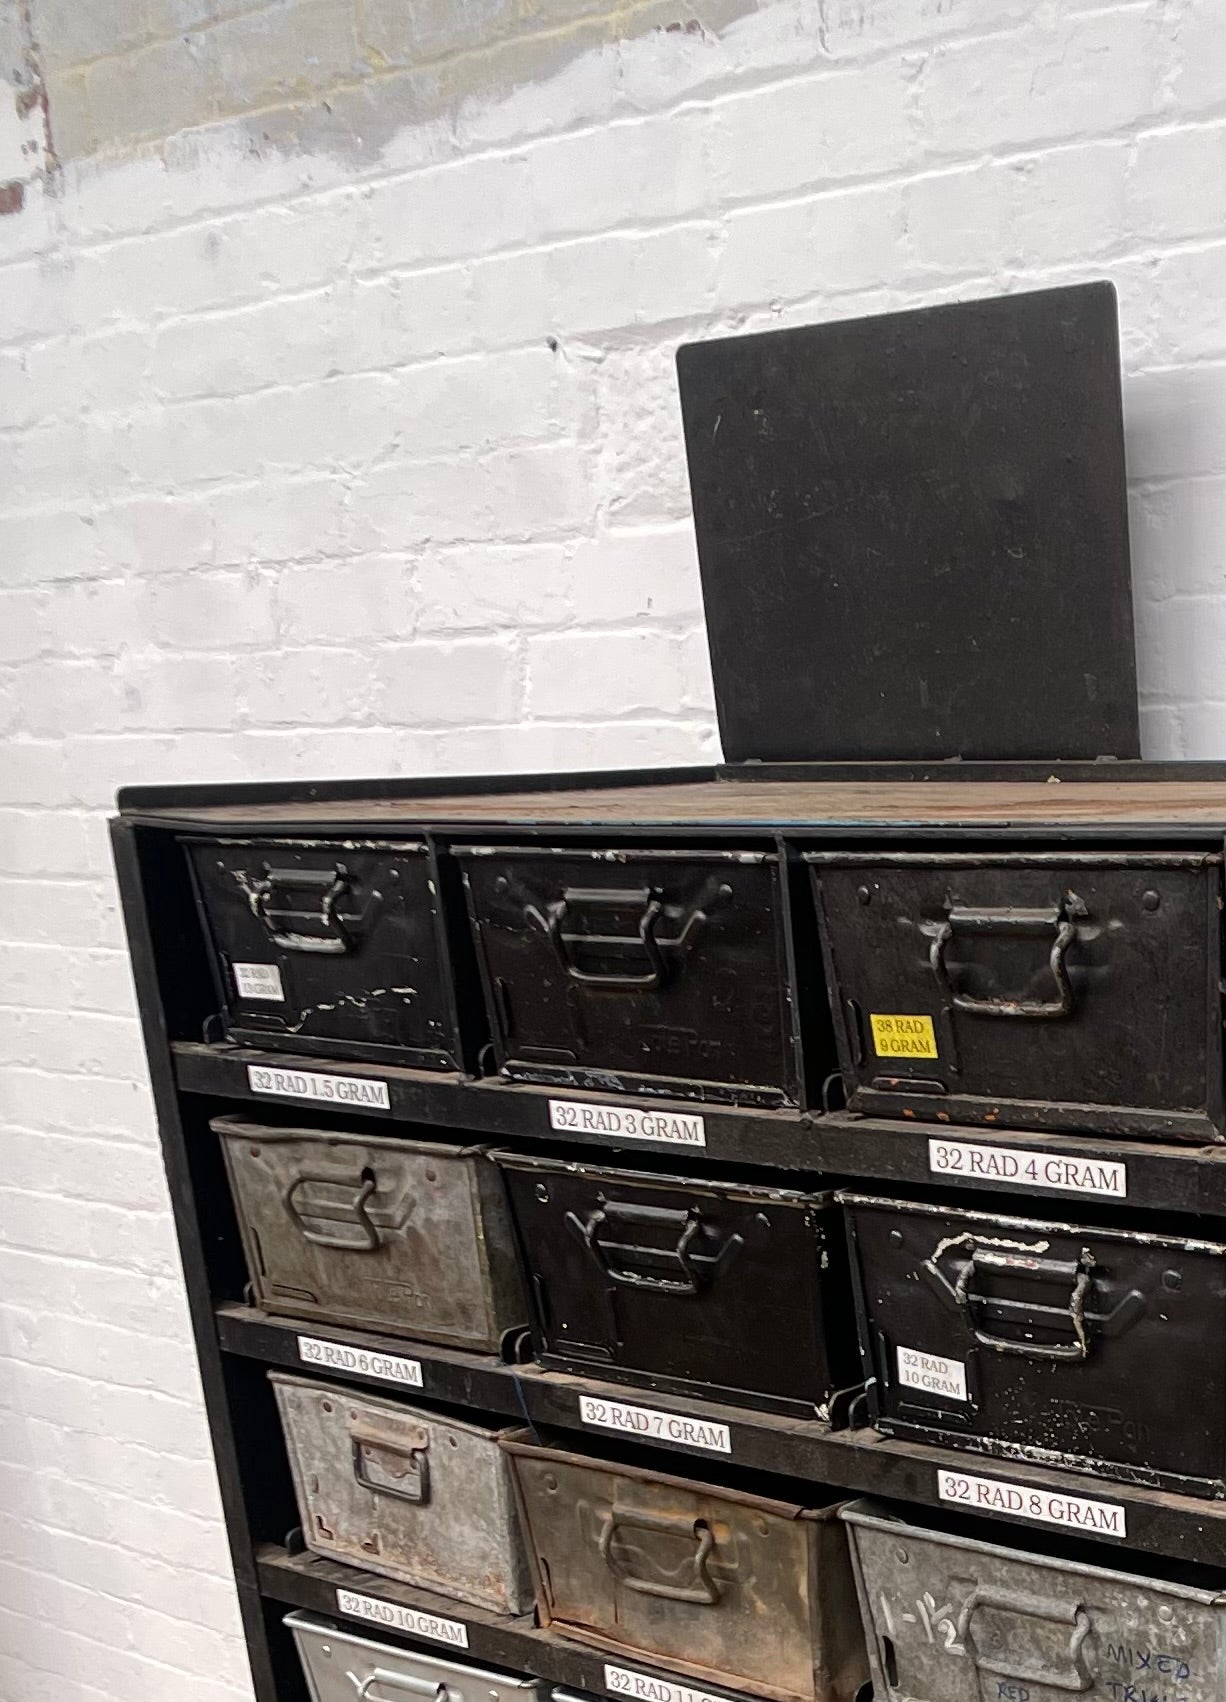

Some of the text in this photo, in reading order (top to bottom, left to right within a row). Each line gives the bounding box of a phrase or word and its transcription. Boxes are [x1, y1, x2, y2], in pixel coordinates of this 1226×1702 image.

[877, 1019, 924, 1034] 38 RAD
[880, 1038, 931, 1053] 9 GRAM
[253, 1070, 385, 1105] 32 RAD 1.5 GRAM
[556, 1106, 700, 1142] 32 RAD 3 GRAM
[936, 1146, 1120, 1192] 32 RAD 4 GRAM
[303, 1342, 419, 1382] 32 RAD 6 GRAM
[903, 1352, 948, 1374] 32 RAD
[905, 1369, 961, 1395] 10 GRAM
[586, 1402, 726, 1449] 32 RAD 7 GRAM
[945, 1476, 1119, 1532] 32 RAD 8 GRAM
[343, 1594, 464, 1644] 32 RAD 10 GRAM
[1105, 1643, 1190, 1678] MIXED
[610, 1670, 632, 1691] 32
[634, 1677, 671, 1702] RAD
[998, 1681, 1030, 1702] RED
